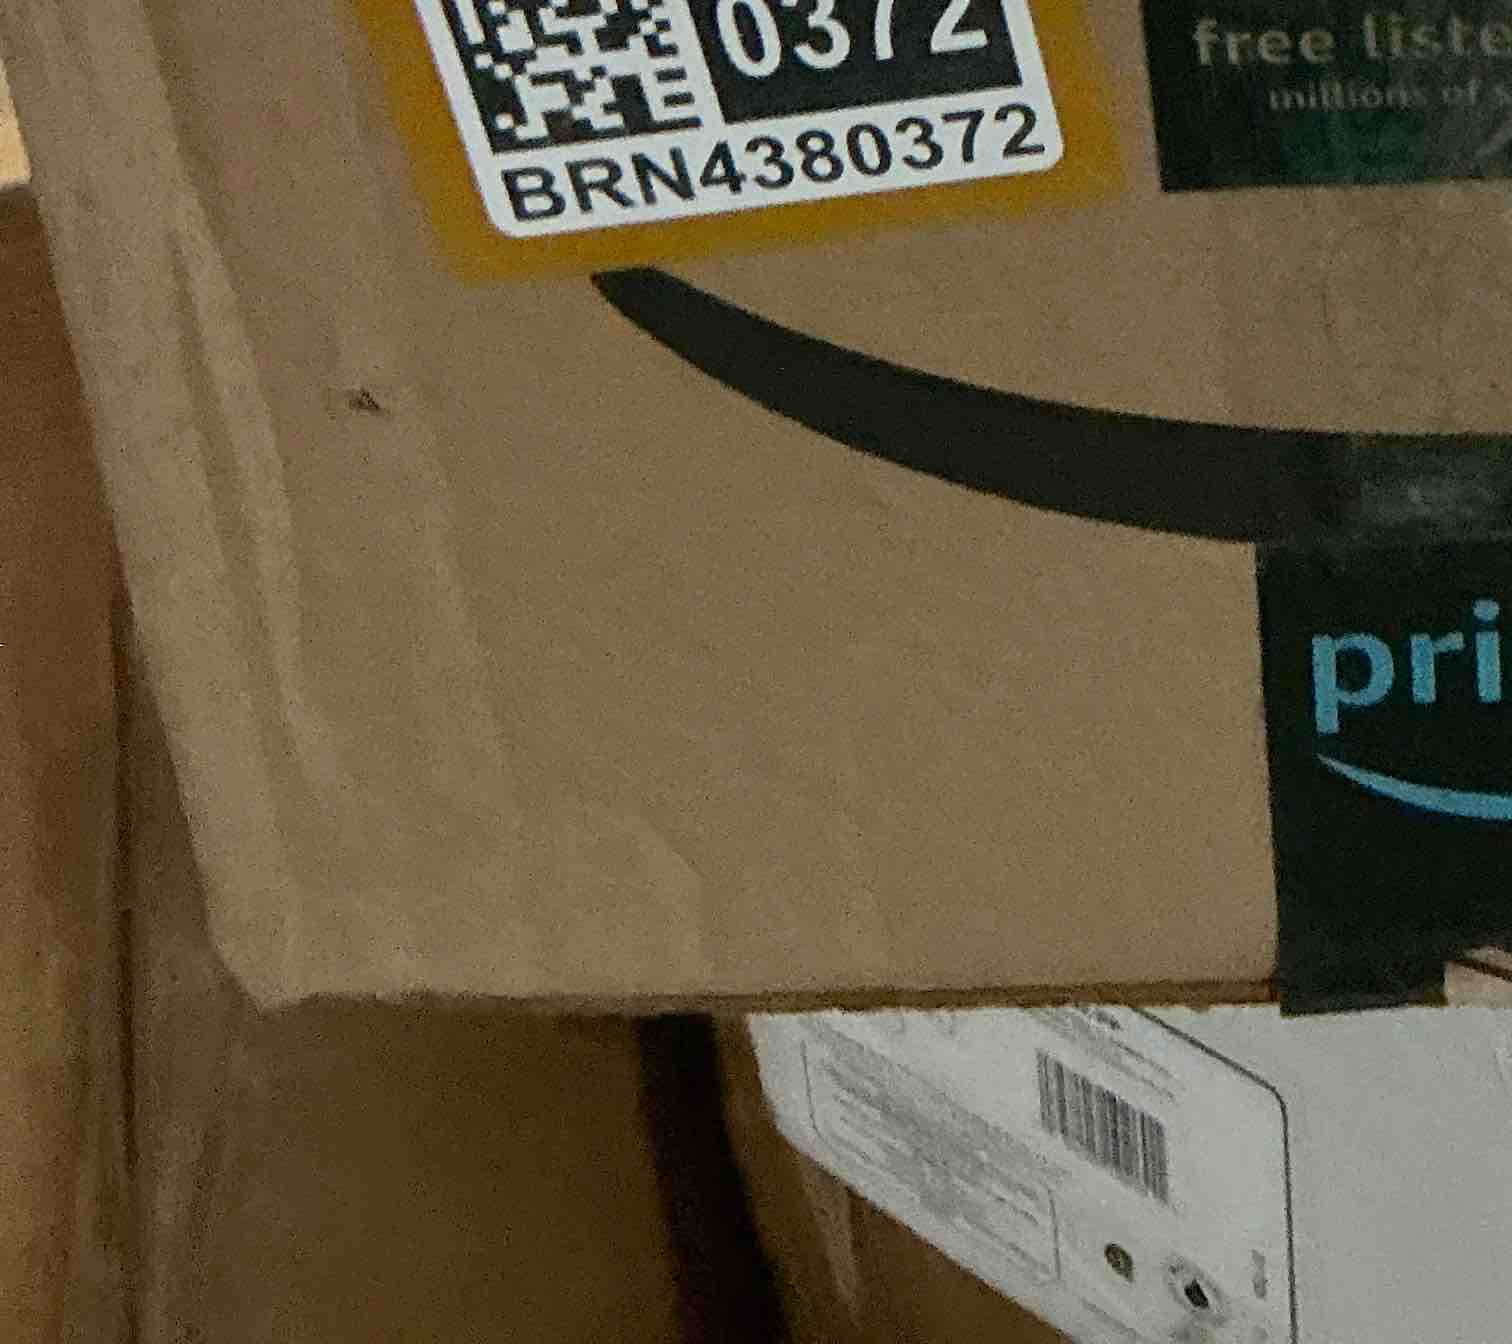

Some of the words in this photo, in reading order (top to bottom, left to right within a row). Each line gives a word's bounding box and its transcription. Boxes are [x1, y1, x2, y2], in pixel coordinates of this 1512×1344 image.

[1194, 16, 1338, 67] free
[1269, 75, 1425, 112] millions
[1441, 76, 1480, 108] of
[501, 103, 1046, 223] BRN4380372
